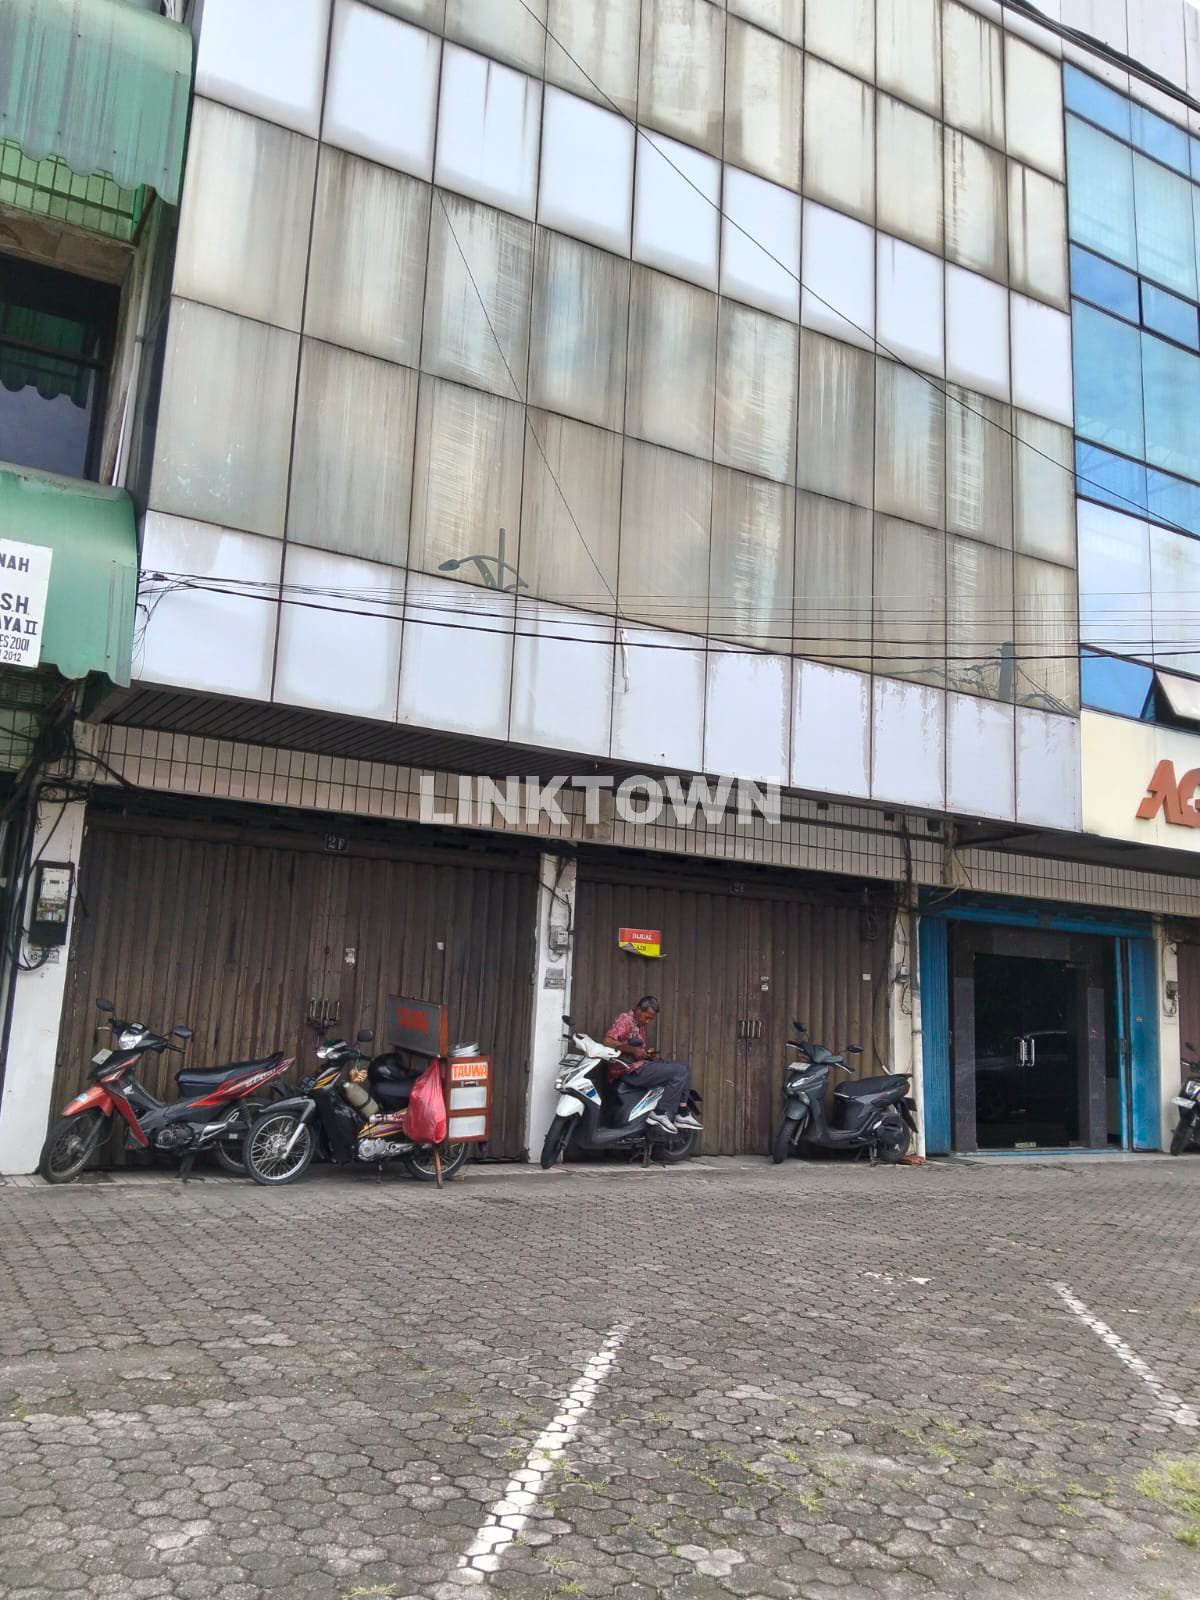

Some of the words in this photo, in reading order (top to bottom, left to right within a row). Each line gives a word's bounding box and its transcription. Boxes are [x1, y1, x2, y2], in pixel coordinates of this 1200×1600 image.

[0, 614, 21, 633] YA
[9, 636, 30, 651] 2001
[3, 650, 21, 662] 2012
[452, 1064, 489, 1079] TAUWA
